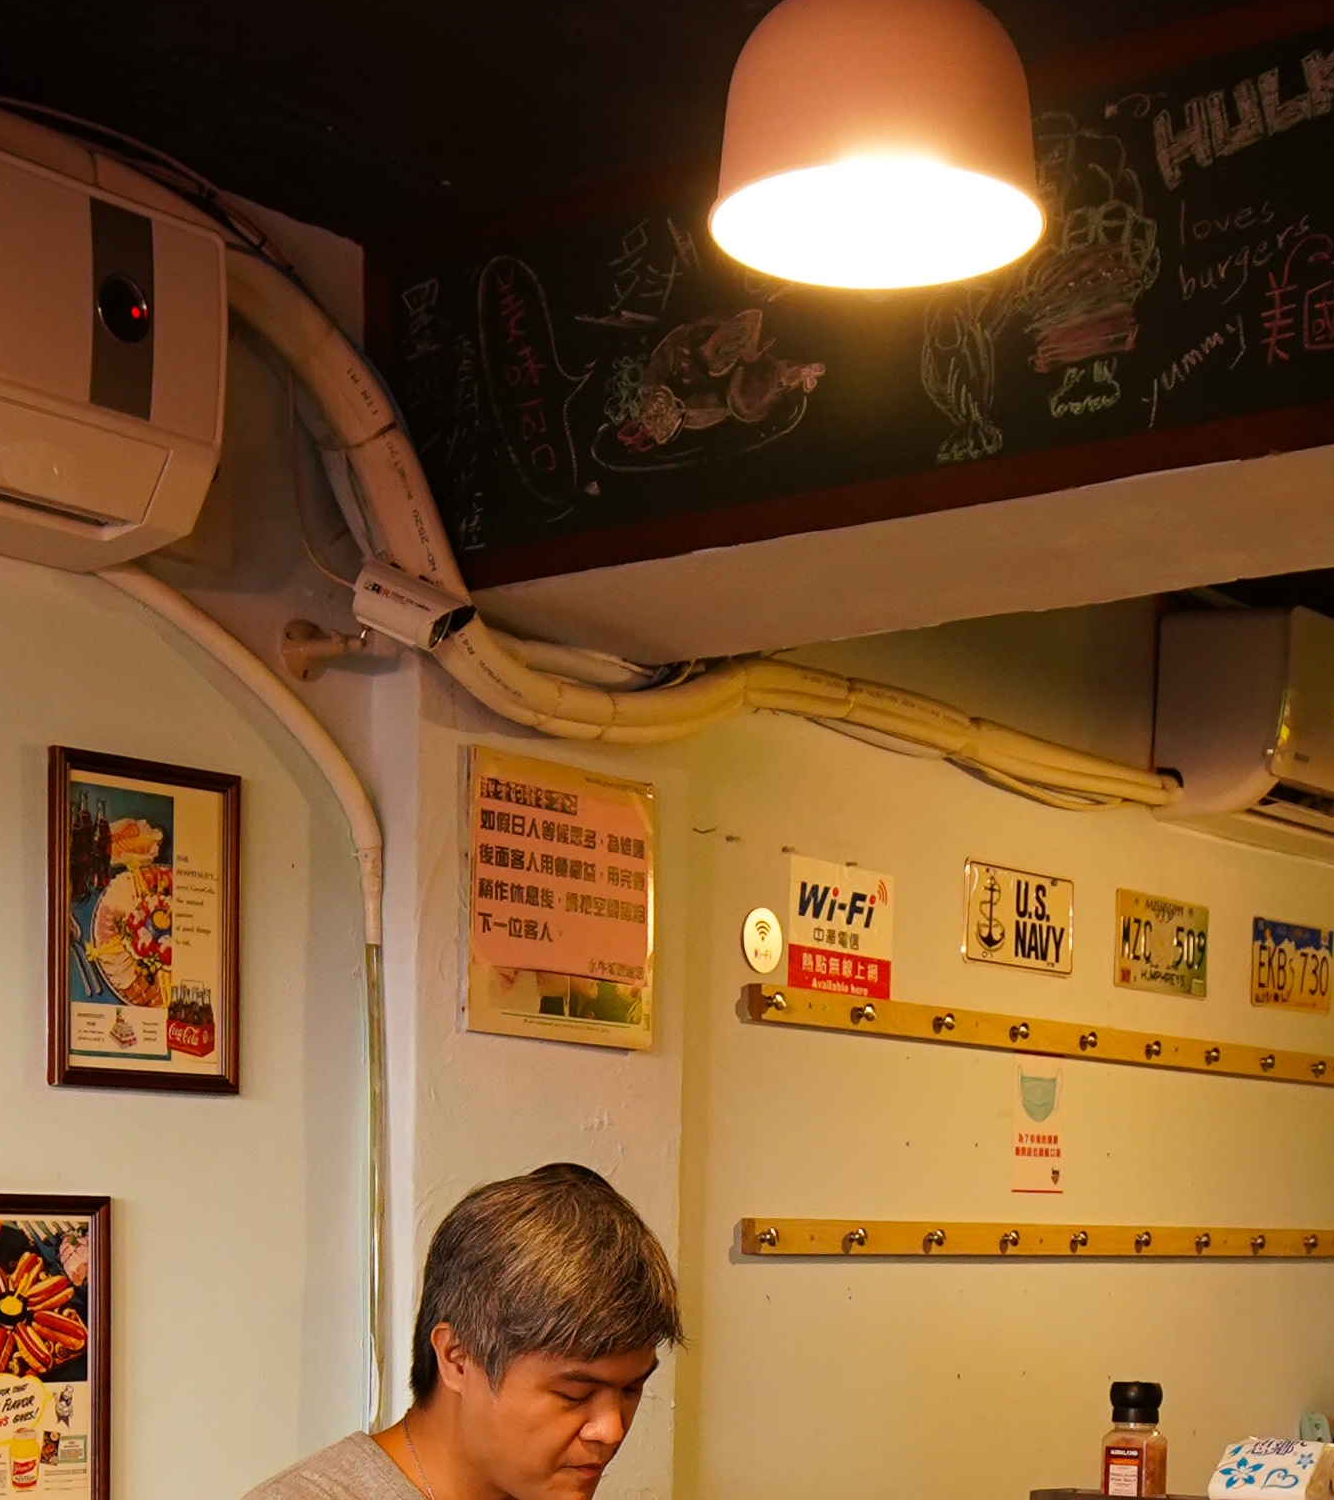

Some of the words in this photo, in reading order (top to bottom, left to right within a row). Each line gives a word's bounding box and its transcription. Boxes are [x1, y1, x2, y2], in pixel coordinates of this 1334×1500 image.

[1180, 199, 1274, 245] loves
[1178, 212, 1311, 306] burgers
[495, 272, 559, 474] 美味可口
[1141, 313, 1246, 429] yummy
[798, 881, 877, 928] Wi-Fi
[1015, 879, 1050, 922] U.S.
[813, 927, 860, 950] 中華電信
[1014, 920, 1065, 964] NAVY
[1120, 915, 1154, 962] MZC
[1173, 926, 1206, 970] 509
[801, 952, 879, 983] 熱點無線上網
[811, 978, 849, 994] Available
[851, 985, 869, 996] here
[1257, 945, 1287, 990] EKB
[1299, 952, 1329, 996] 730
[2, 1395, 35, 1412] FLAVOR
